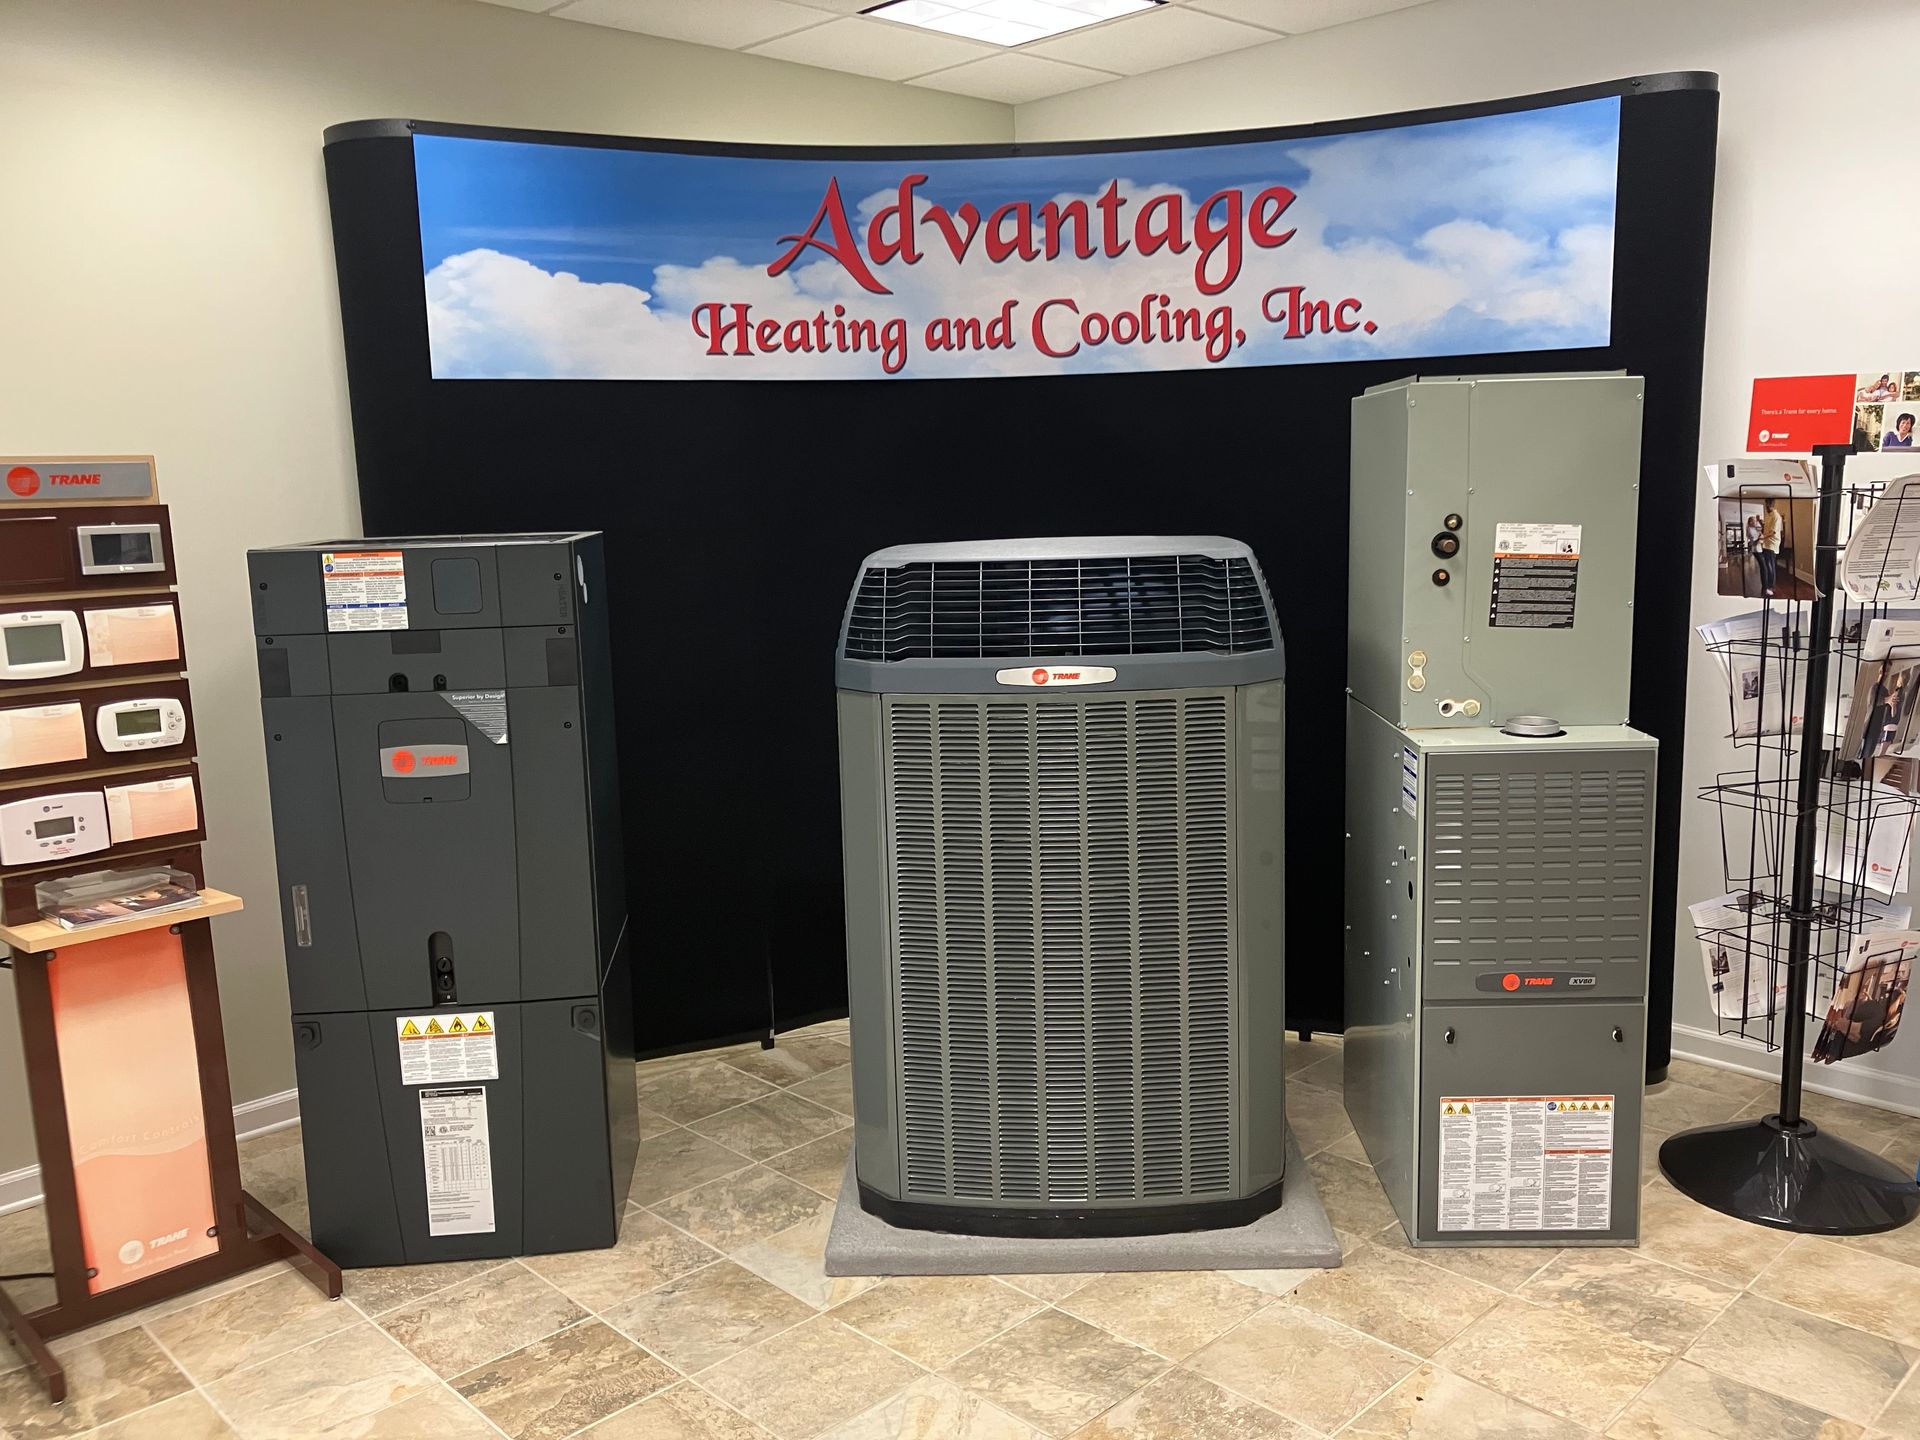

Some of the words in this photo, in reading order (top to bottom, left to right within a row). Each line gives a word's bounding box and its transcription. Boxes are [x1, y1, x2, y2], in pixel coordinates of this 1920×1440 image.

[767, 174, 1298, 295] Advantage
[691, 302, 908, 374] Heating
[925, 300, 1017, 351] and
[1031, 294, 1247, 363] Cooling,
[1261, 286, 1379, 340] Inc.
[48, 474, 102, 486] TRANE
[1052, 672, 1081, 680] TRANE
[476, 693, 485, 701] by
[1524, 977, 1555, 986] TRANE
[148, 1227, 190, 1249] TRANE
